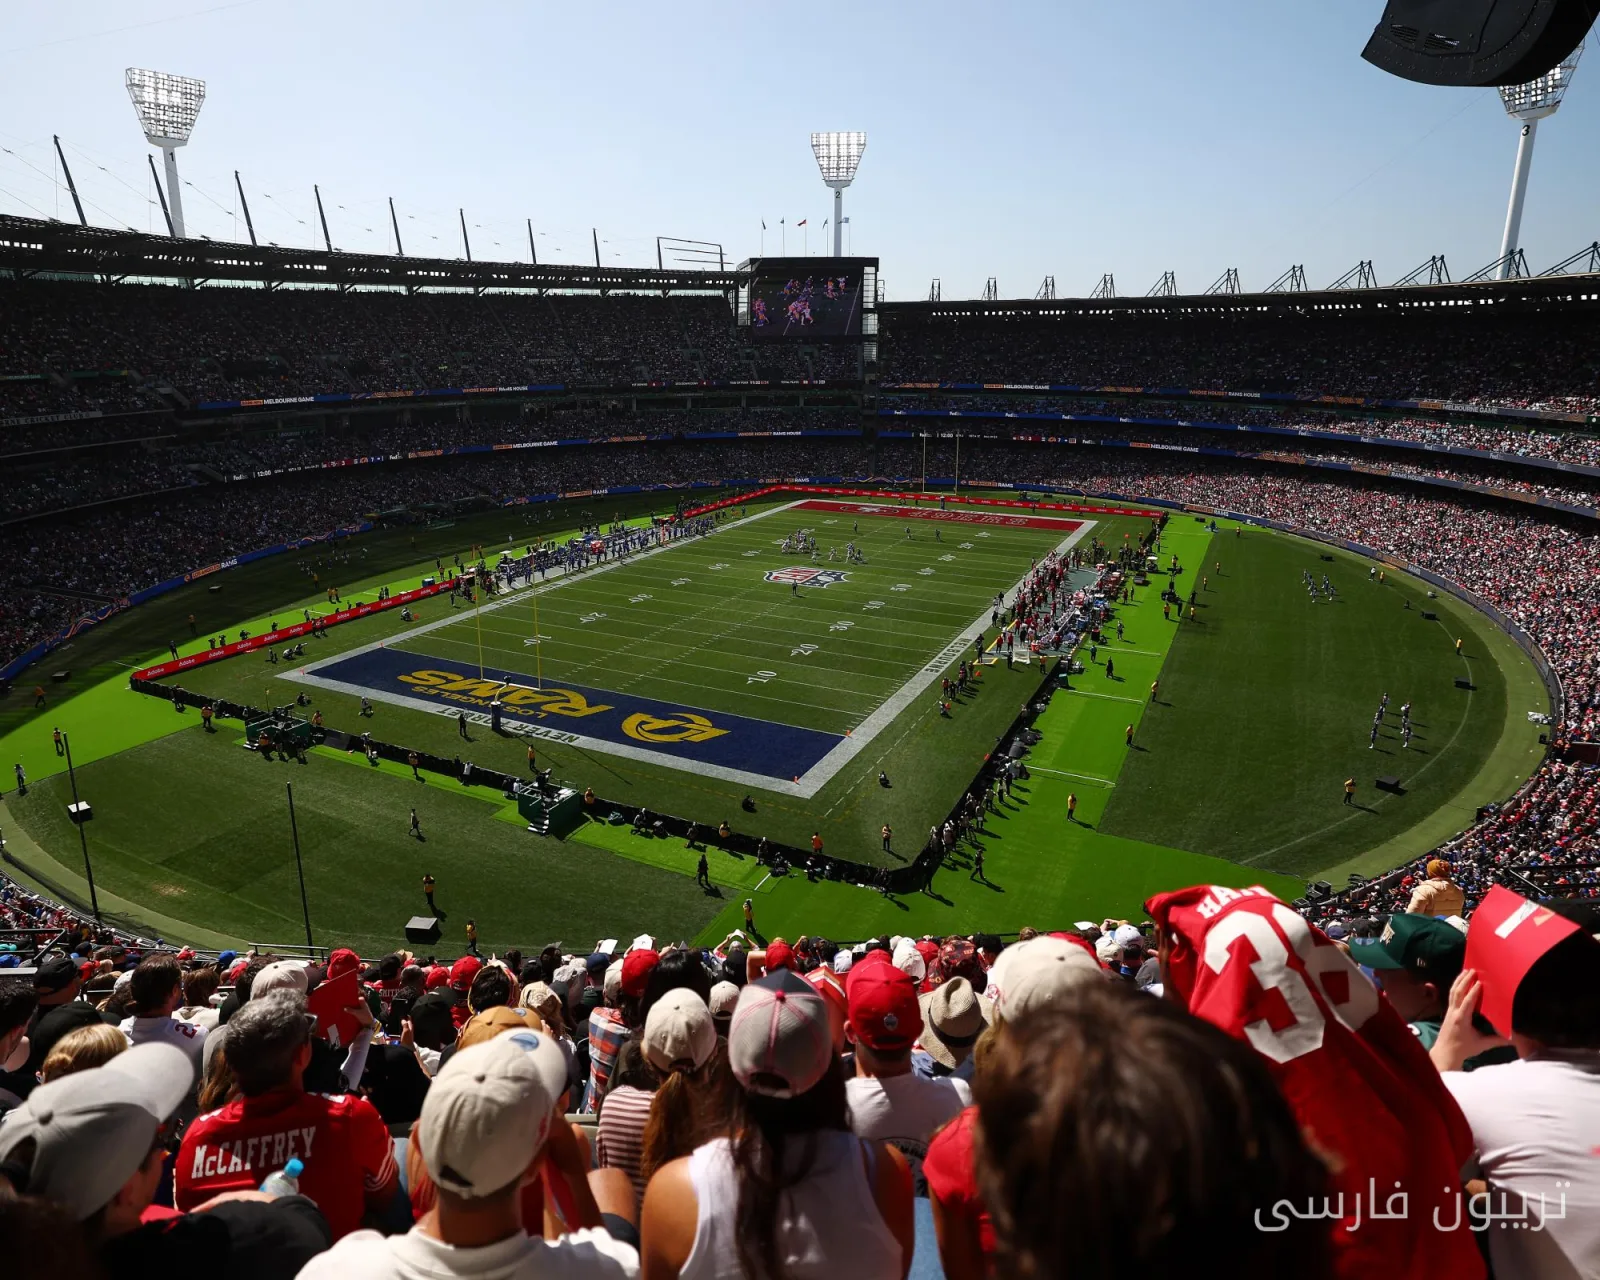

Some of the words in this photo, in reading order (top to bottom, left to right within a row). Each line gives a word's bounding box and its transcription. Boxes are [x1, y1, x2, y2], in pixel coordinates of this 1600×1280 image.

[1521, 124, 1530, 136] 3
[169, 151, 175, 162] 1
[835, 190, 841, 199] 2
[263, 397, 298, 405] MELBOURNE
[1442, 404, 1478, 412] MELBOURNE
[1151, 443, 1183, 451] MELBOURNE
[221, 558, 238, 569] RAMS
[336, 612, 350, 620] Adobe
[579, 611, 607, 622] 20
[289, 626, 303, 634] Adobe
[830, 620, 855, 630] 30
[263, 633, 278, 641] Adobe
[237, 641, 252, 649] Adobe
[792, 643, 819, 655] 20
[208, 649, 224, 658] Adobe
[925, 638, 972, 673] MELBOURNE
[178, 658, 195, 667] Adobe
[147, 667, 165, 676] Adobe
[748, 670, 777, 683] 10
[397, 671, 614, 718] RAMS
[411, 685, 504, 707] NGELES
[502, 705, 550, 719] LOS
[514, 723, 580, 745] NEVER
[1203, 901, 1380, 1065] 36
[191, 1126, 317, 1179] McCAFFREY
